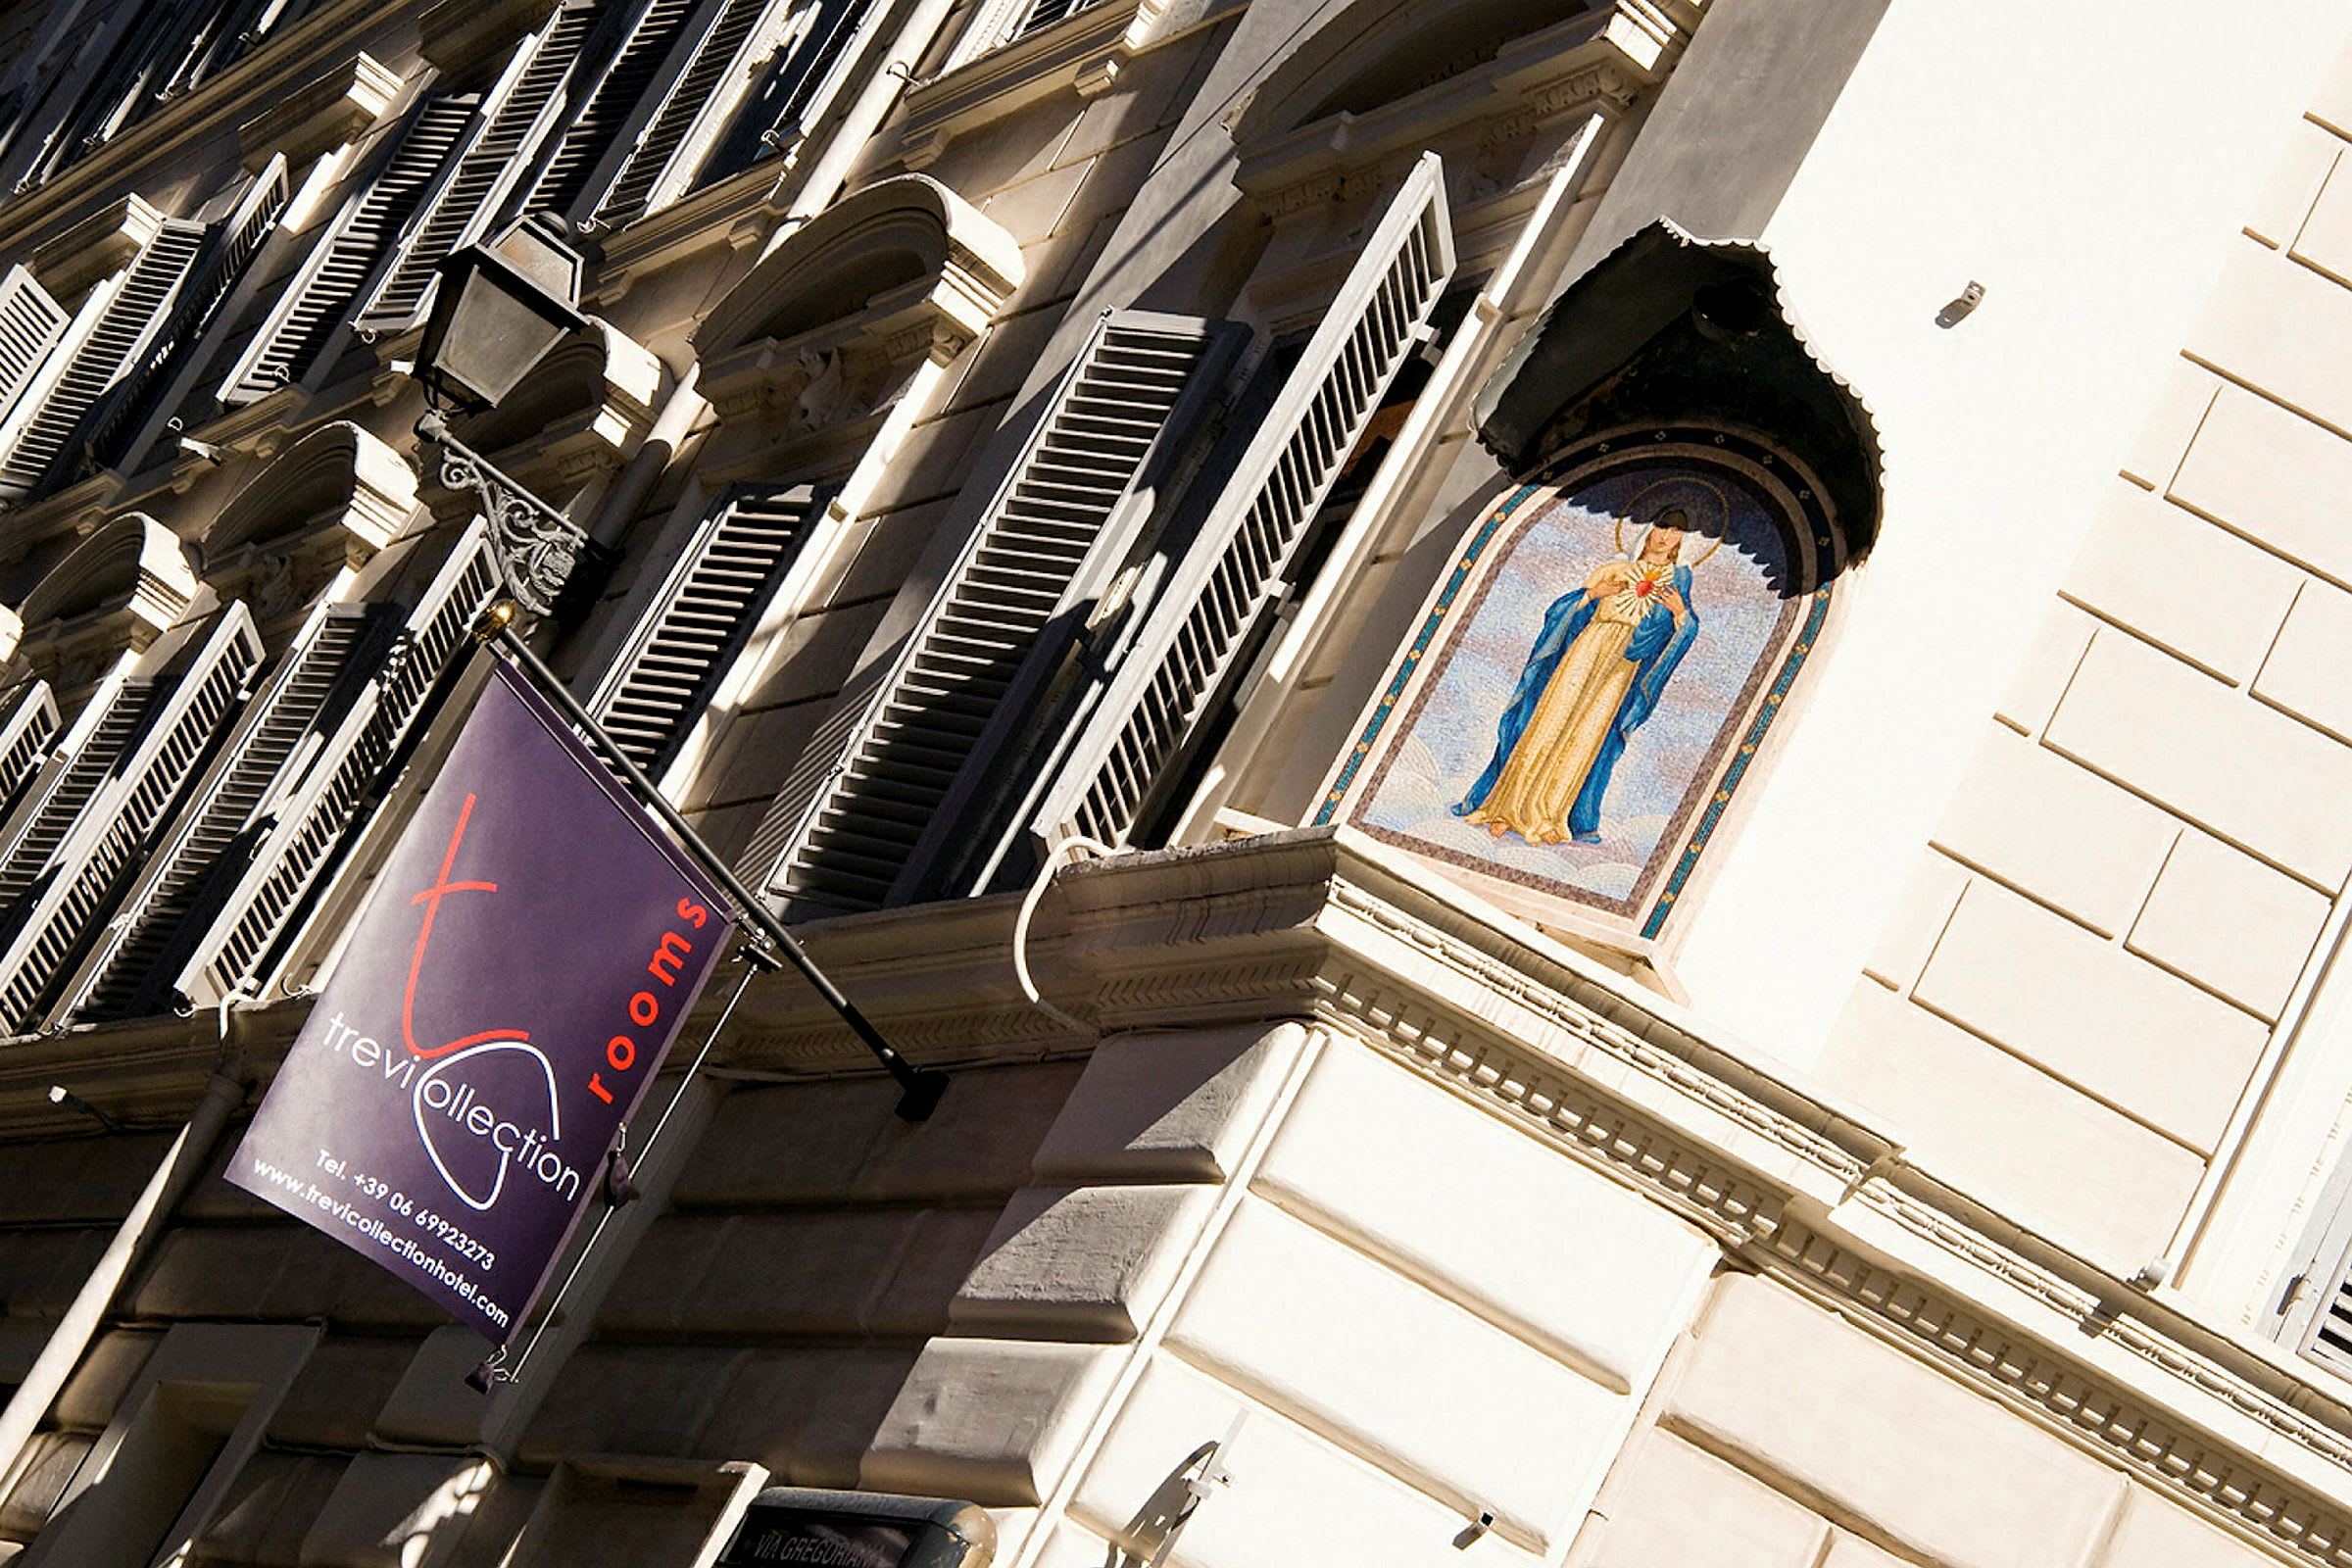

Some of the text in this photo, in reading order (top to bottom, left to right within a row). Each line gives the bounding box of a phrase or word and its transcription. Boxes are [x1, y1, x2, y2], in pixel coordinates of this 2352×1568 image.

[588, 897, 707, 1104] rooms
[253, 1157, 511, 1330] www.trevicollectionhotel.com
[316, 1149, 497, 1272] Tel. +39 06 69923273
[754, 1533, 783, 1560] VIA
